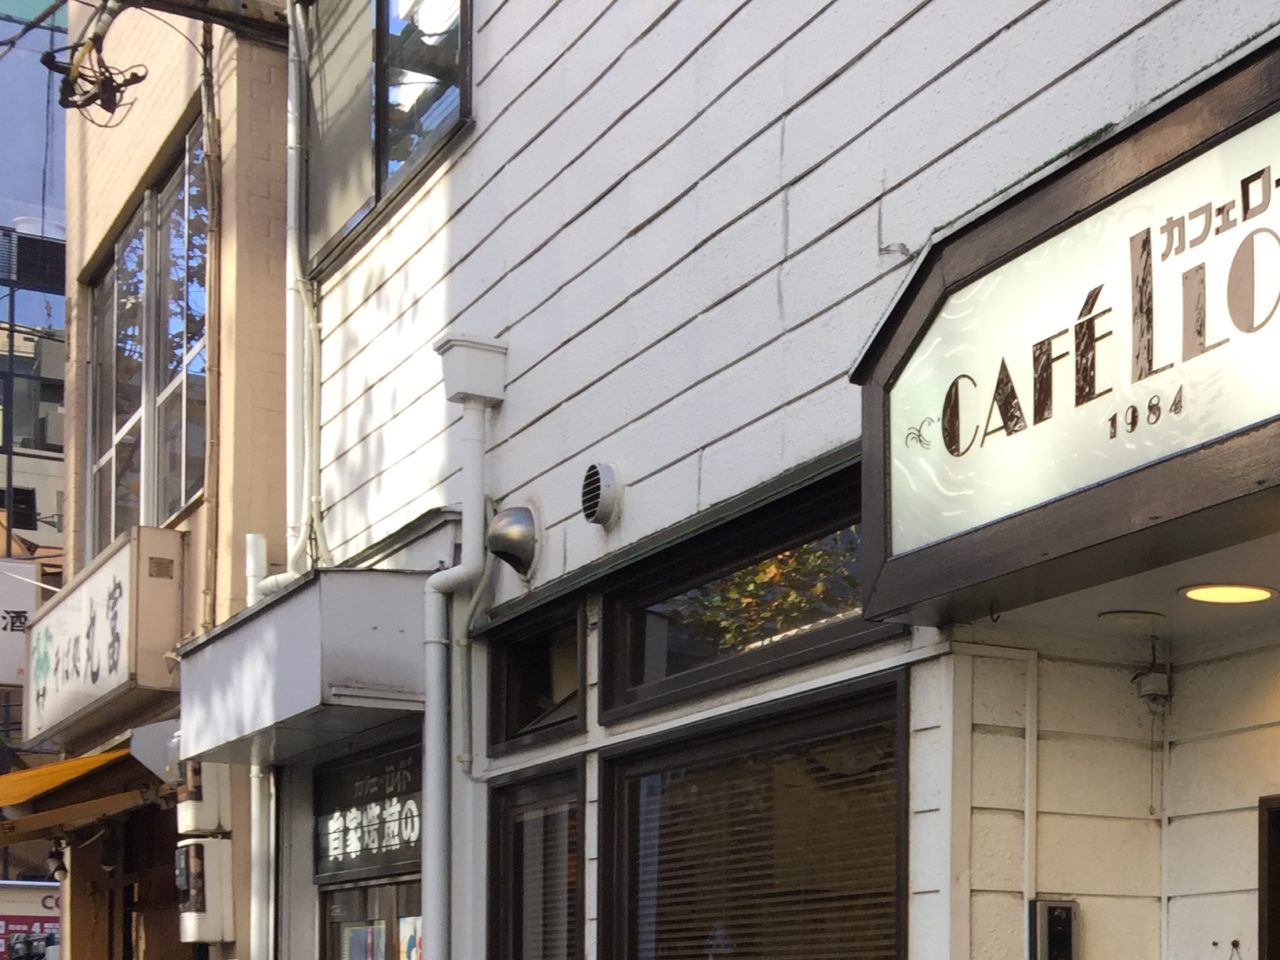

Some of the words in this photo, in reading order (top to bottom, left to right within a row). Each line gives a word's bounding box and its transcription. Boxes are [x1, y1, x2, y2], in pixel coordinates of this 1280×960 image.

[940, 283, 1113, 458] CAFÉ
[1108, 385, 1184, 440] 1984
[2, 609, 28, 633] 酒
[328, 797, 420, 861] 自家焙煎の
